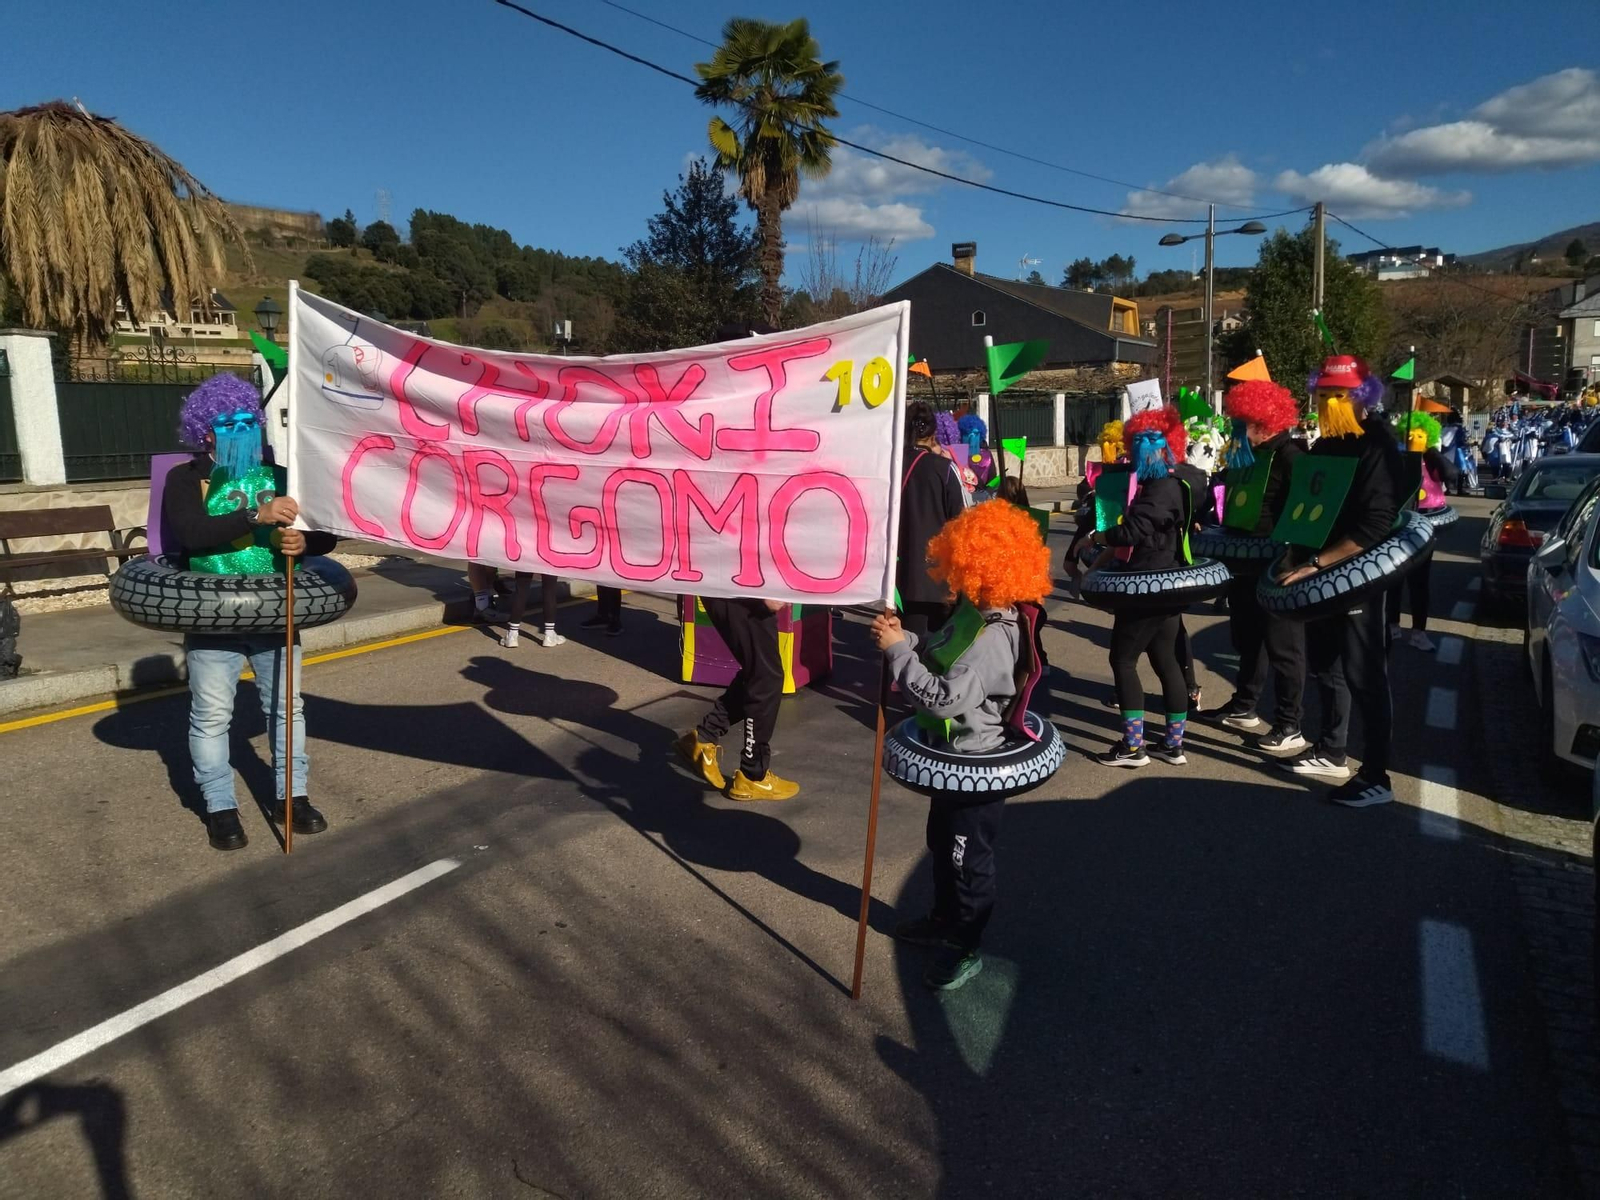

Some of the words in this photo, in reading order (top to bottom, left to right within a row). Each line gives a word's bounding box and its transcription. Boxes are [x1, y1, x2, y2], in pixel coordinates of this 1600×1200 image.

[389, 337, 832, 461] CHOKI
[825, 356, 894, 406] 10
[341, 434, 869, 594] CORGOMO
